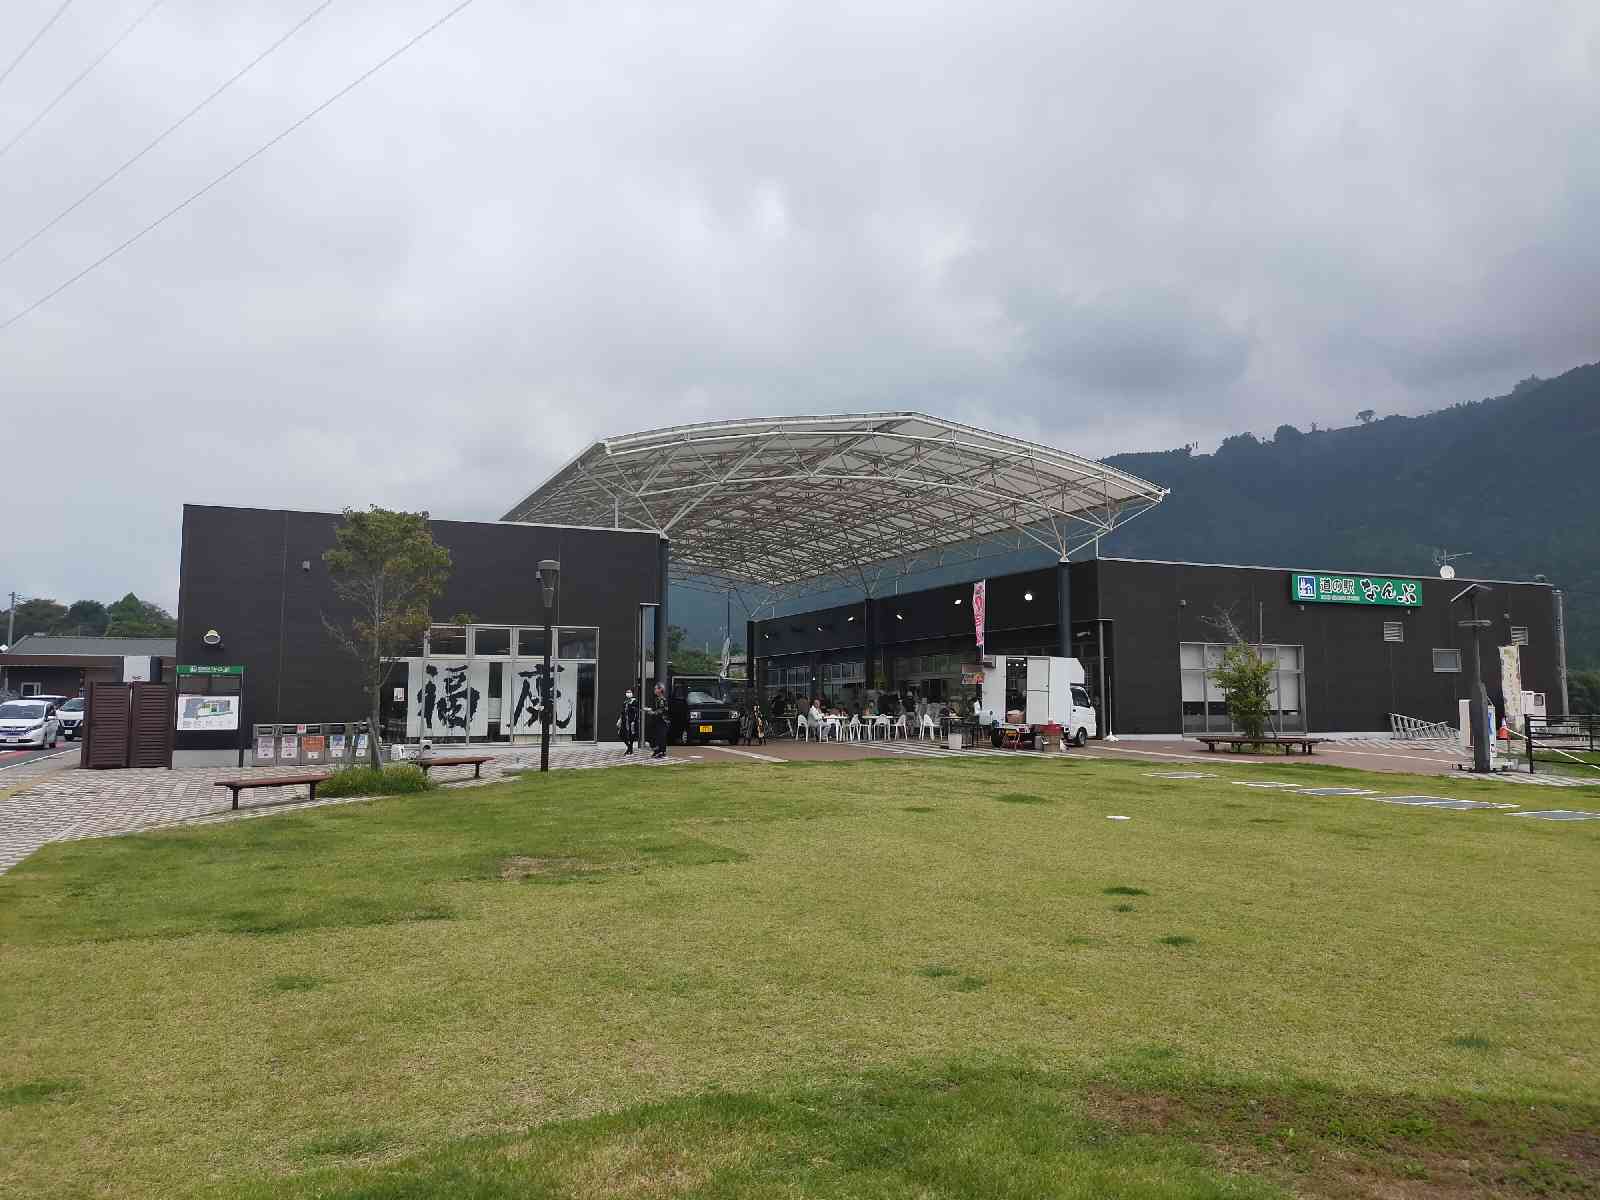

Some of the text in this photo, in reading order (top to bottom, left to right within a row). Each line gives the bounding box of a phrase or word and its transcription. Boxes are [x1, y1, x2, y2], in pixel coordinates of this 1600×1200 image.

[1320, 577, 1417, 604] 道の駅 なんぶ
